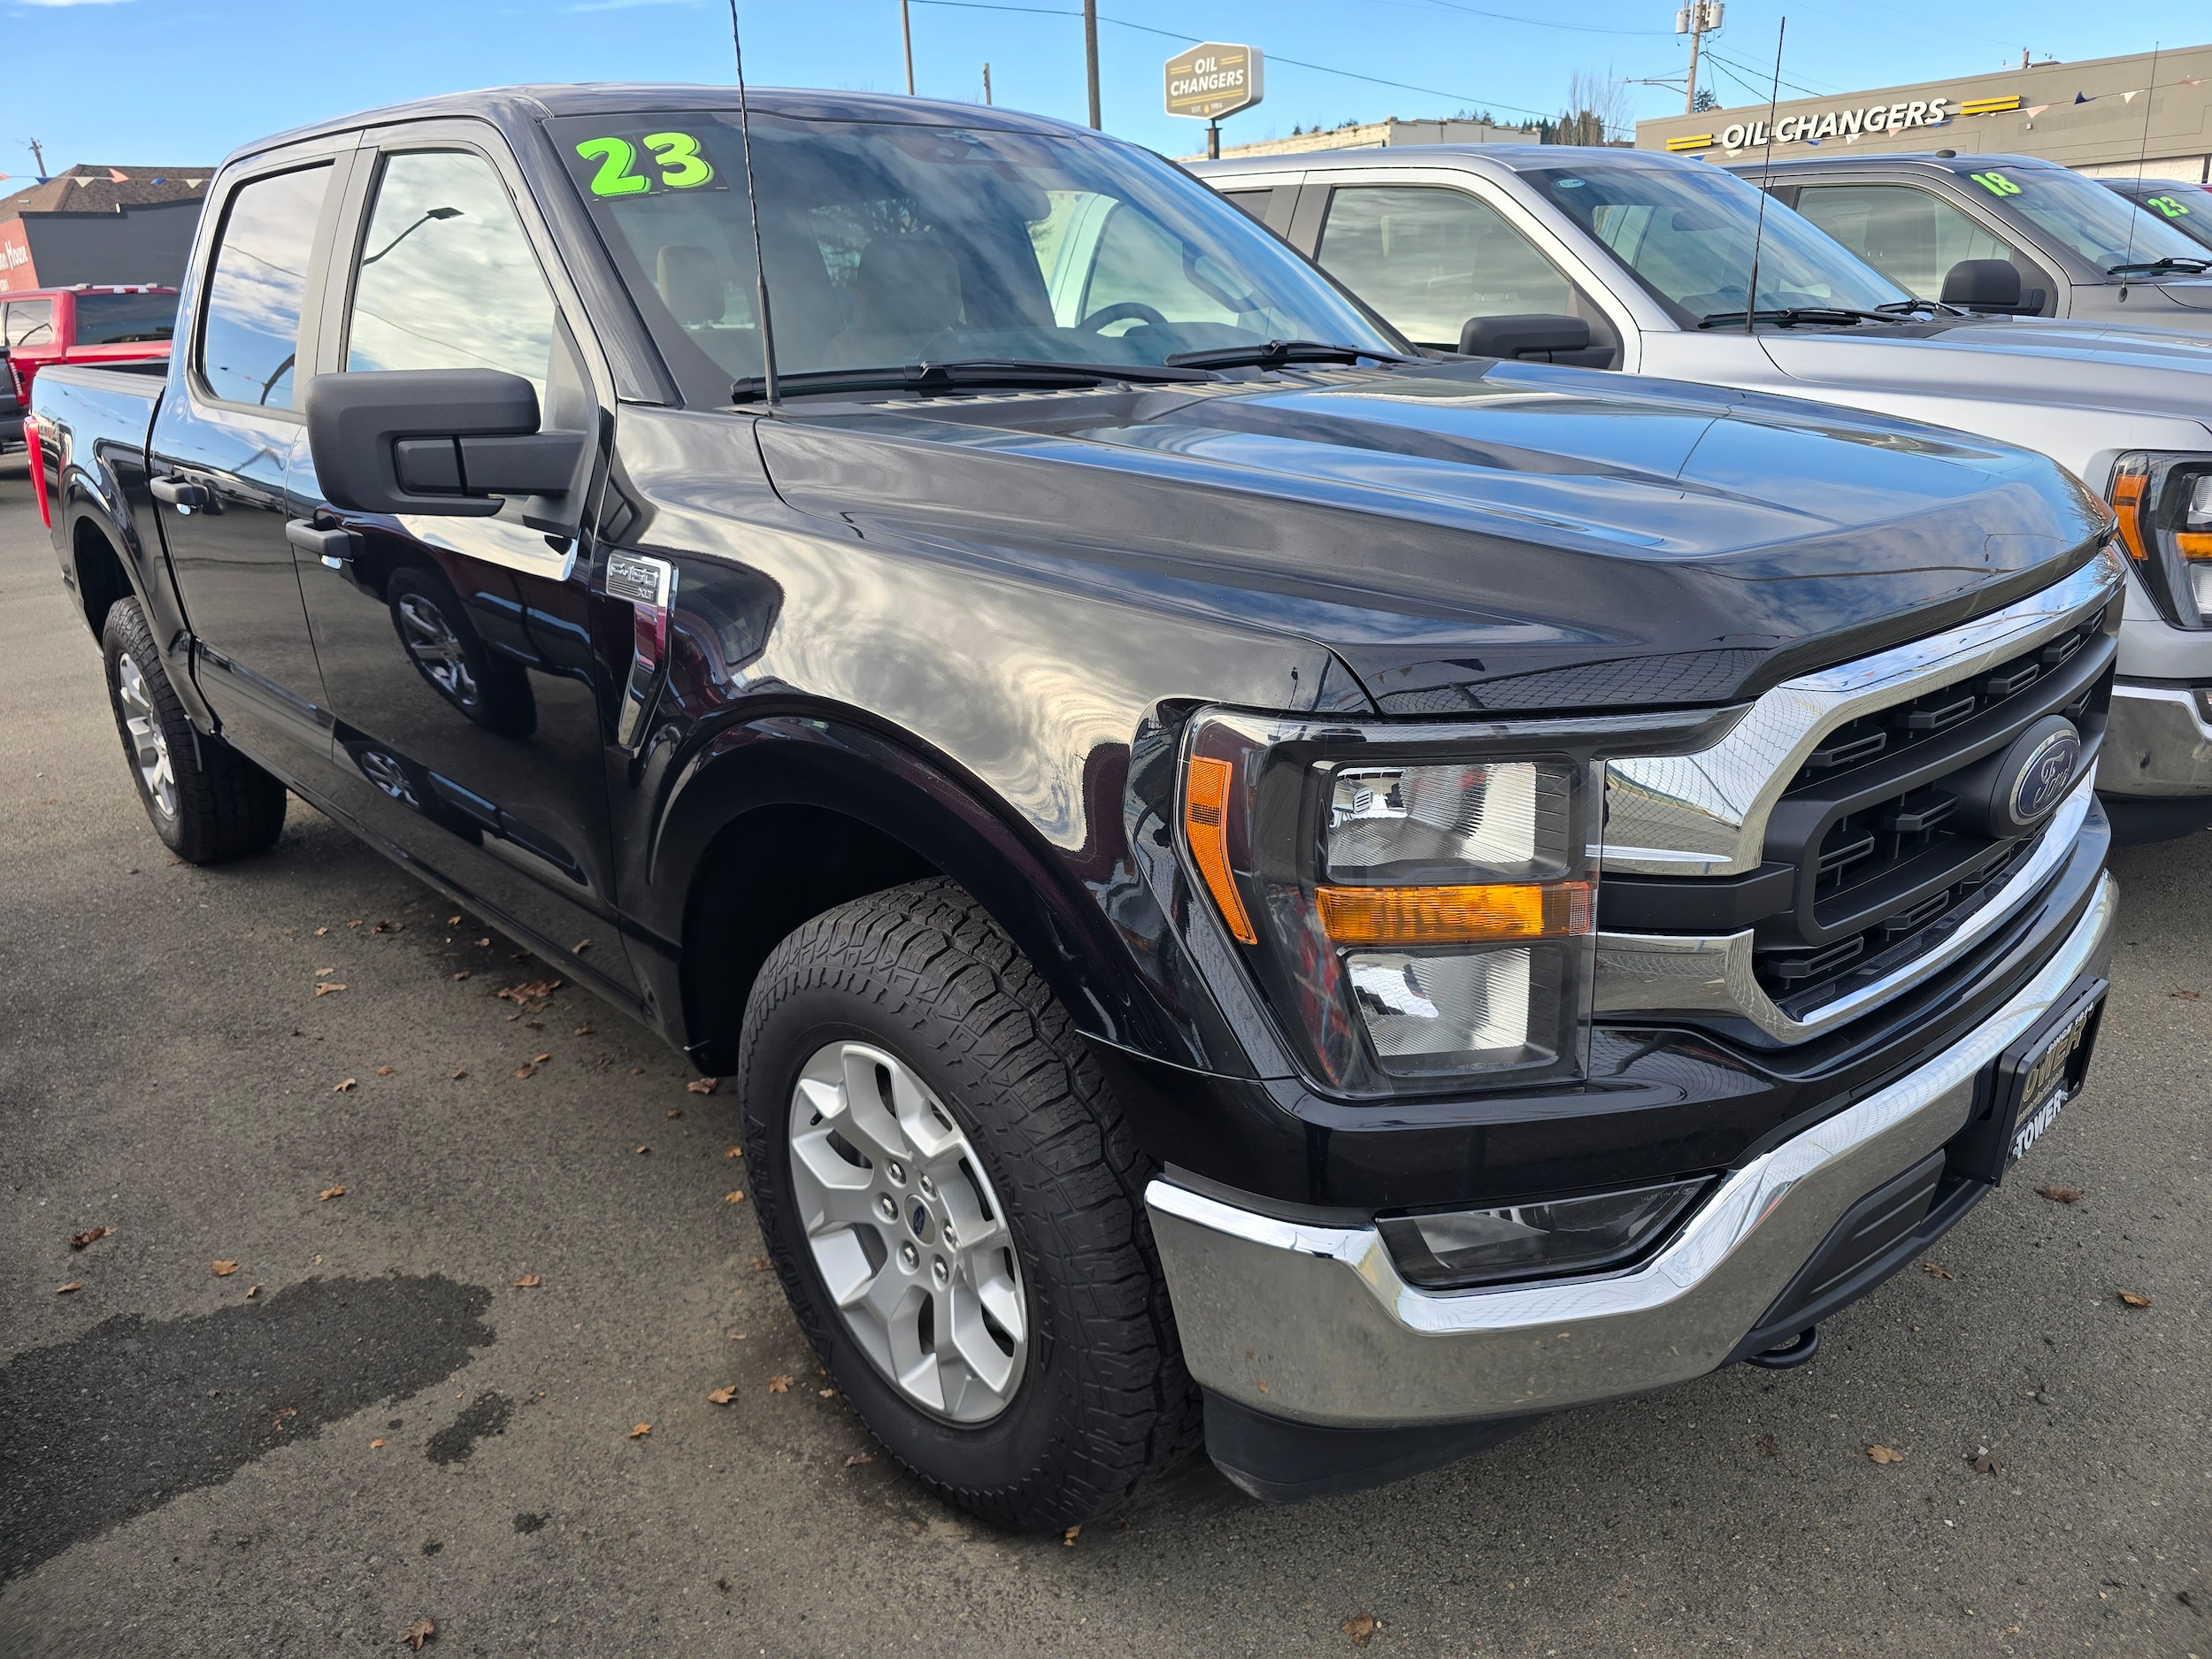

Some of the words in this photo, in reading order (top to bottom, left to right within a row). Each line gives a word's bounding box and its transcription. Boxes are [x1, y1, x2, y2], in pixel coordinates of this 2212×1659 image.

[1194, 56, 1217, 74] OIL
[1170, 69, 1244, 96] CHANGERS
[1722, 120, 1770, 150] OIL
[1775, 97, 1948, 142] CHANGERS
[575, 132, 715, 197] 23
[1970, 172, 2022, 197] 18
[2147, 196, 2190, 218] 23
[611, 563, 659, 588] F-150
[637, 588, 654, 600] XLT
[2032, 749, 2074, 809] Ford
[2016, 1088, 2062, 1160] TOWER
